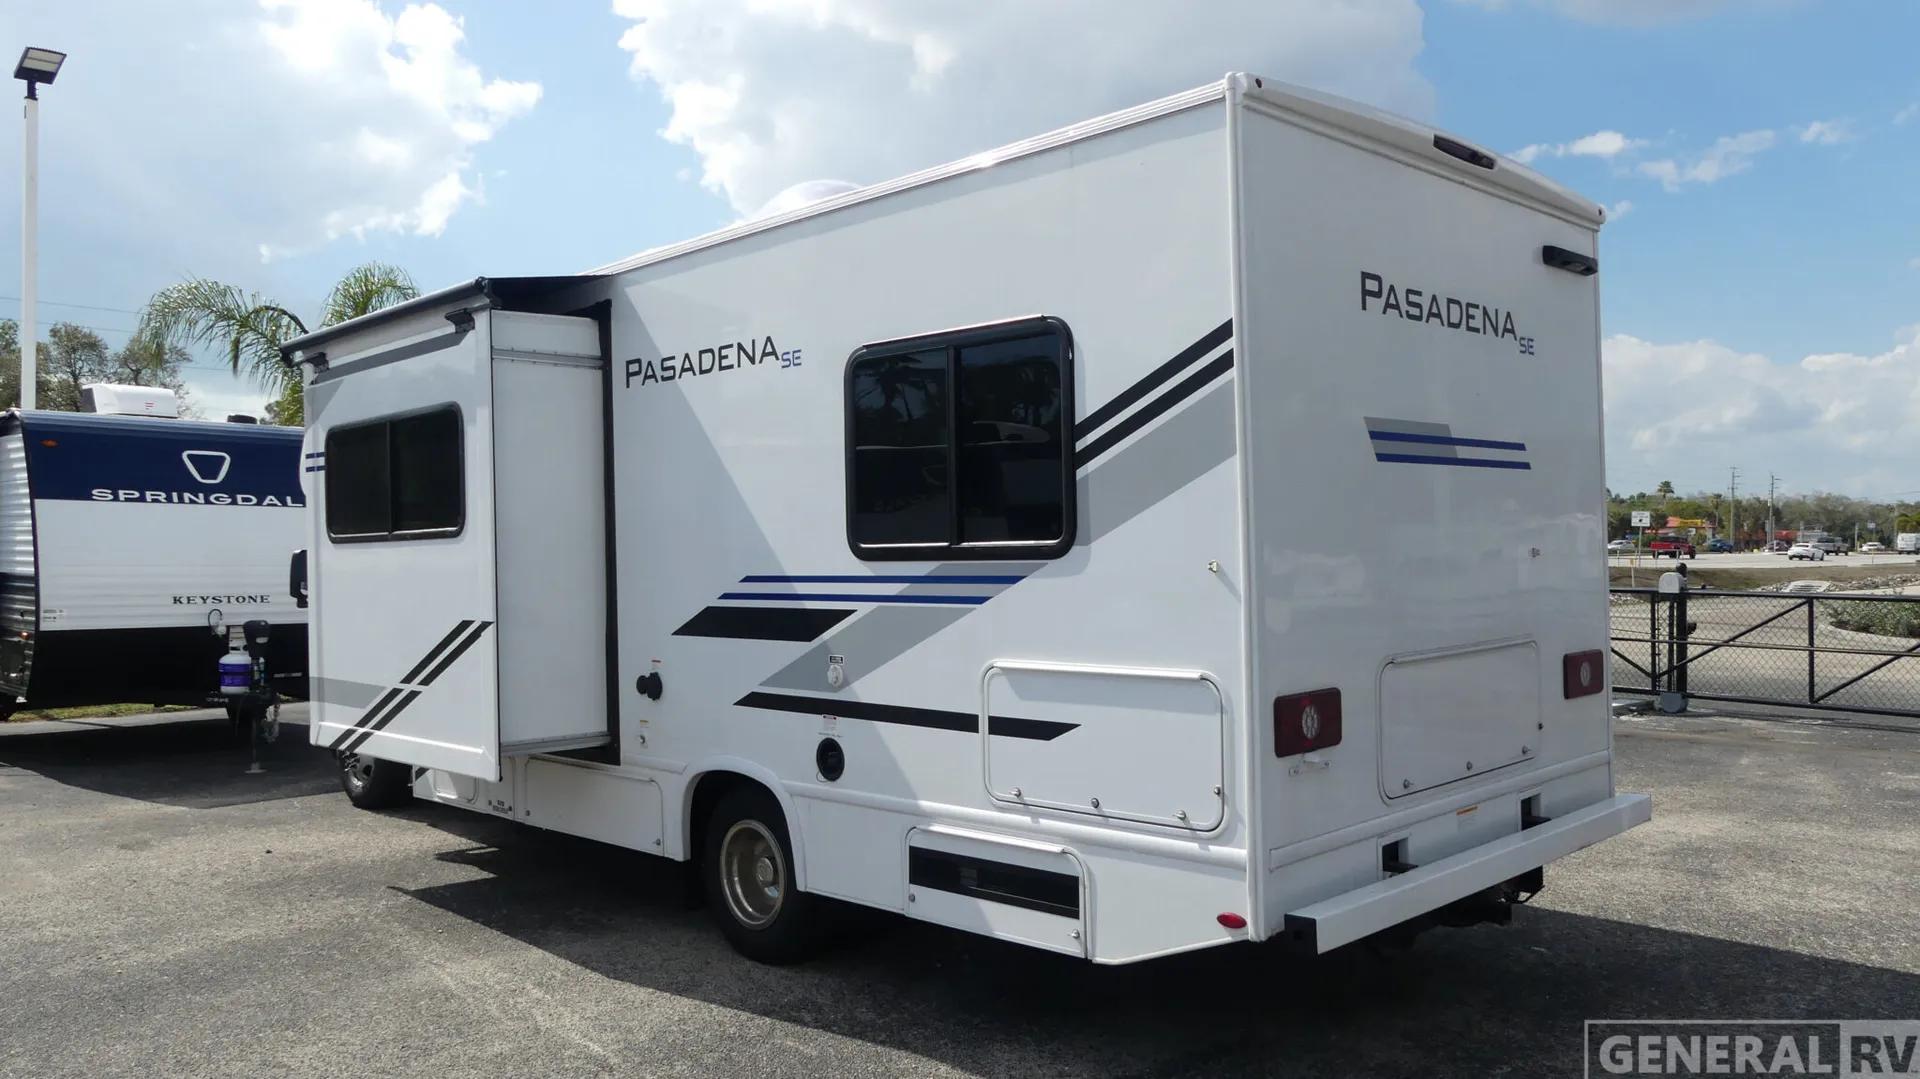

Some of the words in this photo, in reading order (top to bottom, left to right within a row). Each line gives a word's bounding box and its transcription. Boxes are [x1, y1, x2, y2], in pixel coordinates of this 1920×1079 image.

[1360, 271, 1517, 341] PASADENA
[1519, 337, 1535, 355] SE
[625, 335, 780, 389] PASADENA
[781, 349, 802, 369] SE
[91, 488, 303, 507] SPRINGDAL
[172, 595, 270, 605] KEYSTONE
